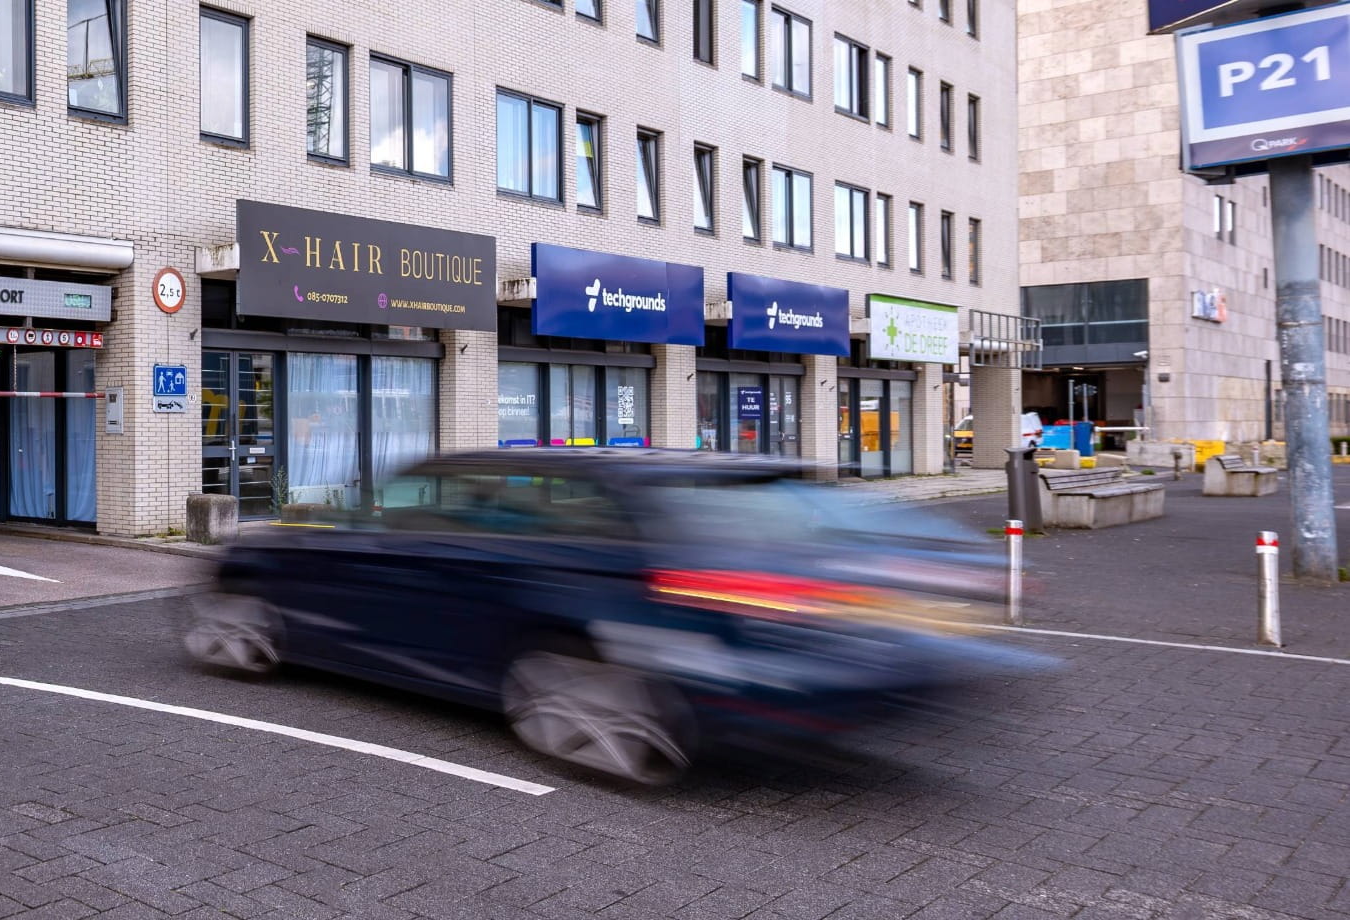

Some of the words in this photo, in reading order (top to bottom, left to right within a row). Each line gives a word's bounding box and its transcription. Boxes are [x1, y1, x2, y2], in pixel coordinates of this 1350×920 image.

[1218, 45, 1330, 97] P21
[304, 235, 385, 275] HAIR
[400, 248, 483, 286] BOUTIQUE
[306, 291, 349, 305] 085-0707312
[390, 298, 467, 315] WWW.XHAIRBOUTIQUE.COM
[601, 287, 667, 314] techgrounds
[777, 308, 824, 330] techgrounds
[904, 332, 917, 353] DE
[920, 333, 948, 356] DREEF
